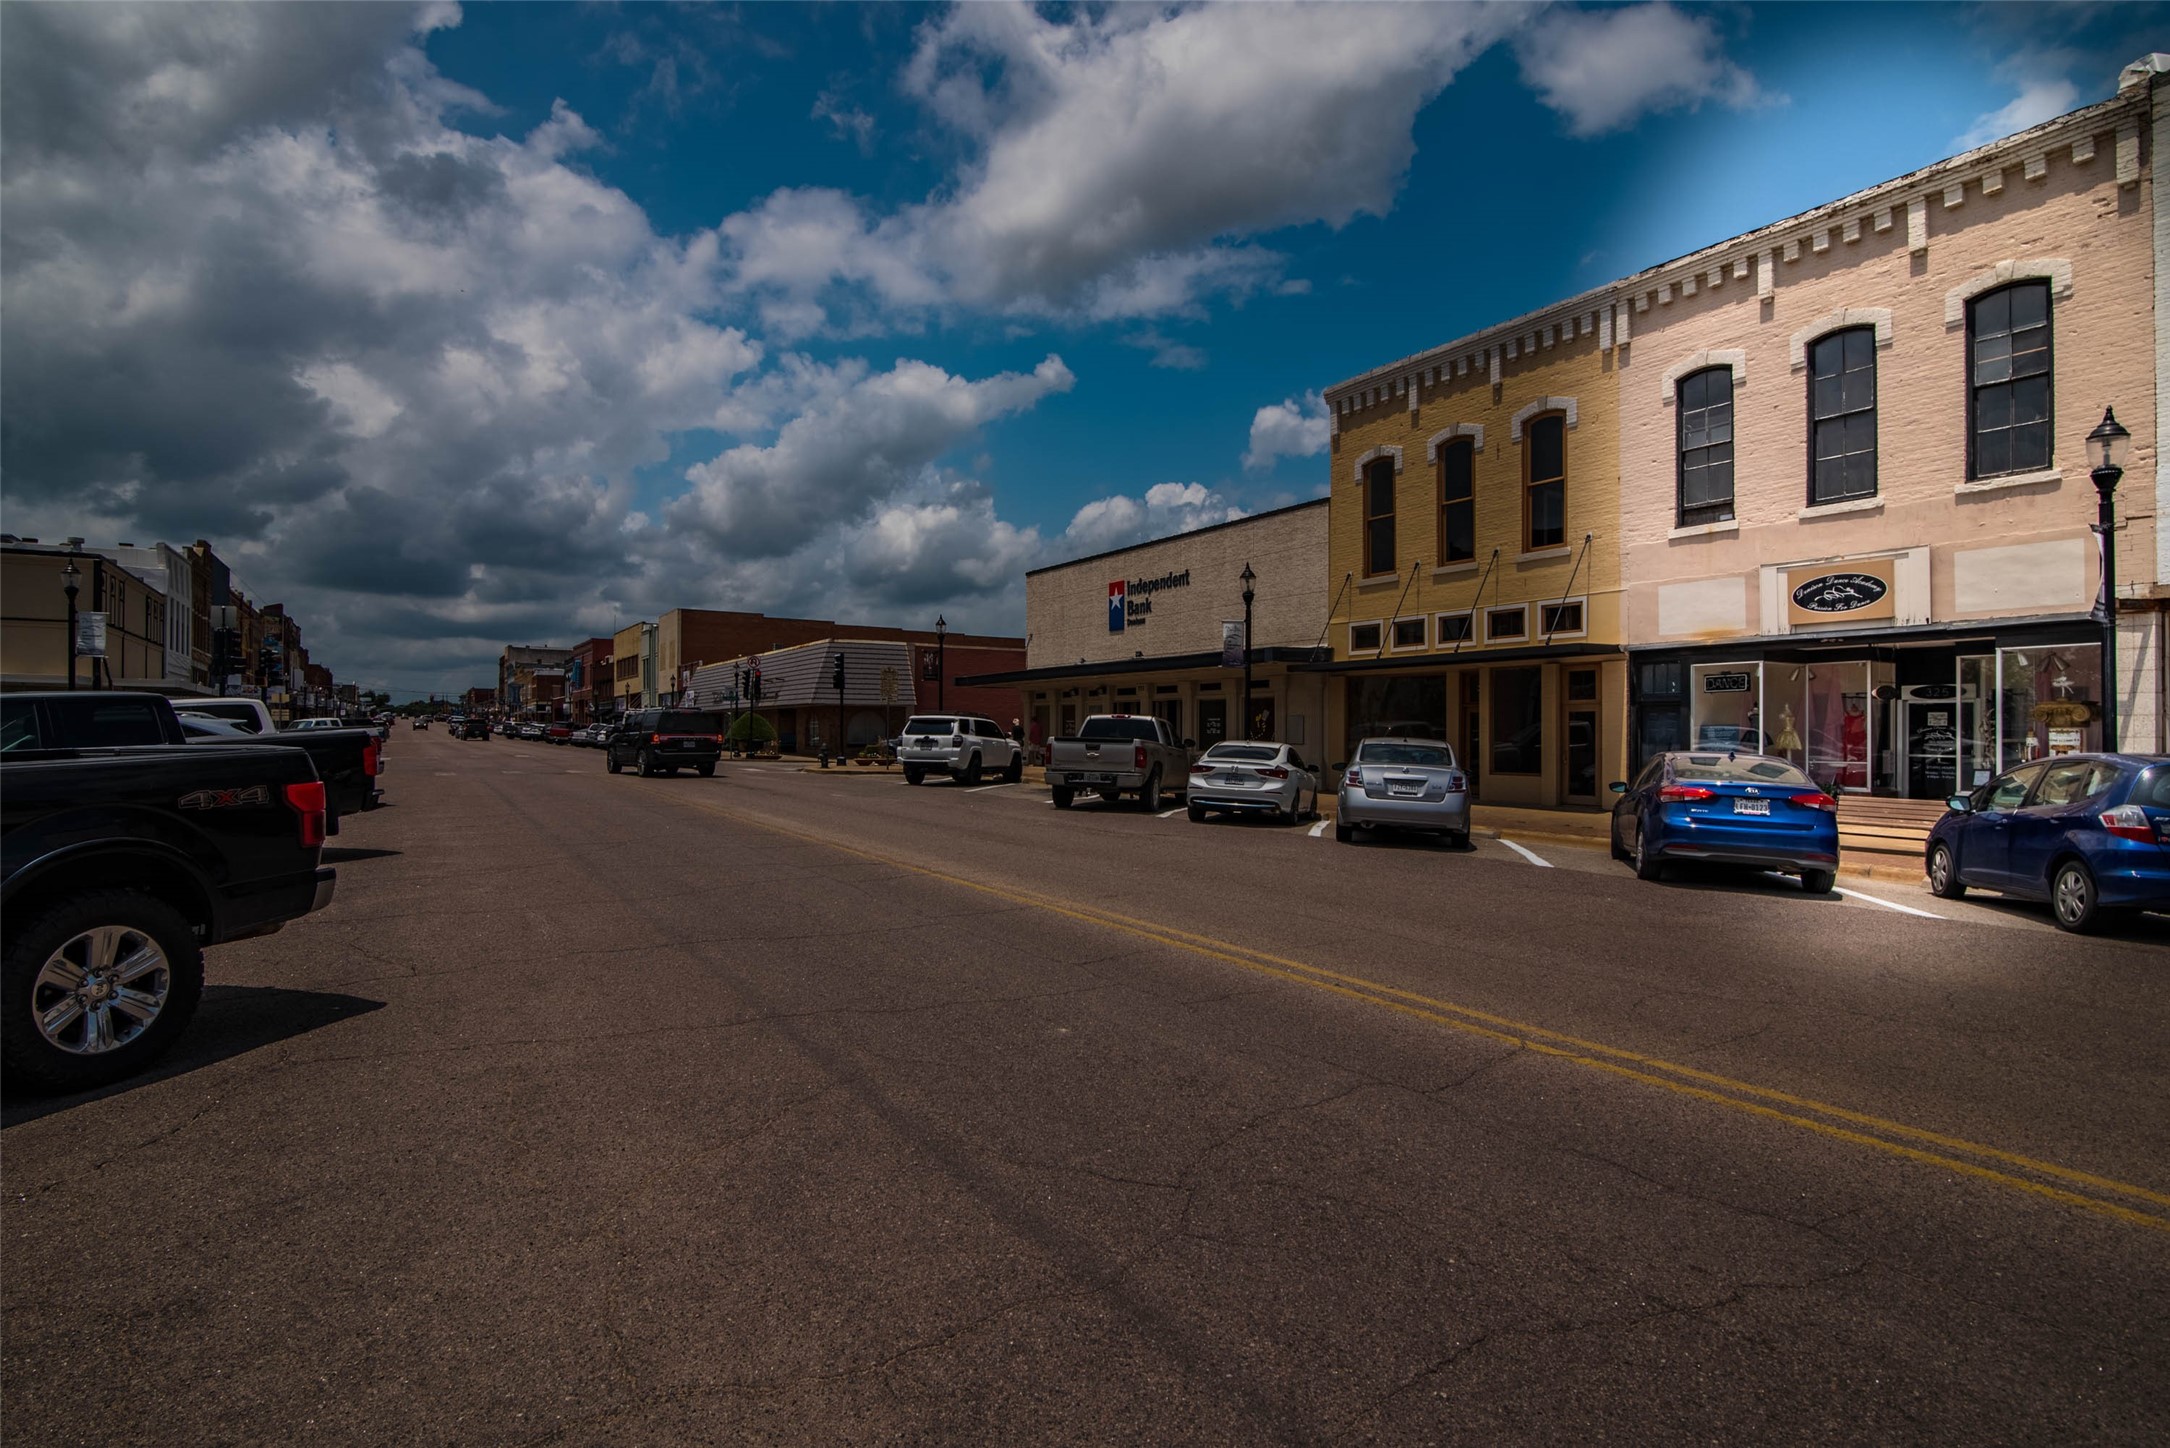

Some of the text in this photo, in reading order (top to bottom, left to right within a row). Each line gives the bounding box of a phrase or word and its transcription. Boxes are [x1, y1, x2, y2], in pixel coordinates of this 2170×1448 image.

[1127, 569, 1190, 597] Independent
[1825, 576, 1849, 586] Dance
[1850, 576, 1882, 592] Academy
[1127, 597, 1152, 616] Bank
[1807, 599, 1871, 612] Passion For Dance
[1706, 677, 1747, 690] DANCE
[1926, 687, 1950, 698] 325
